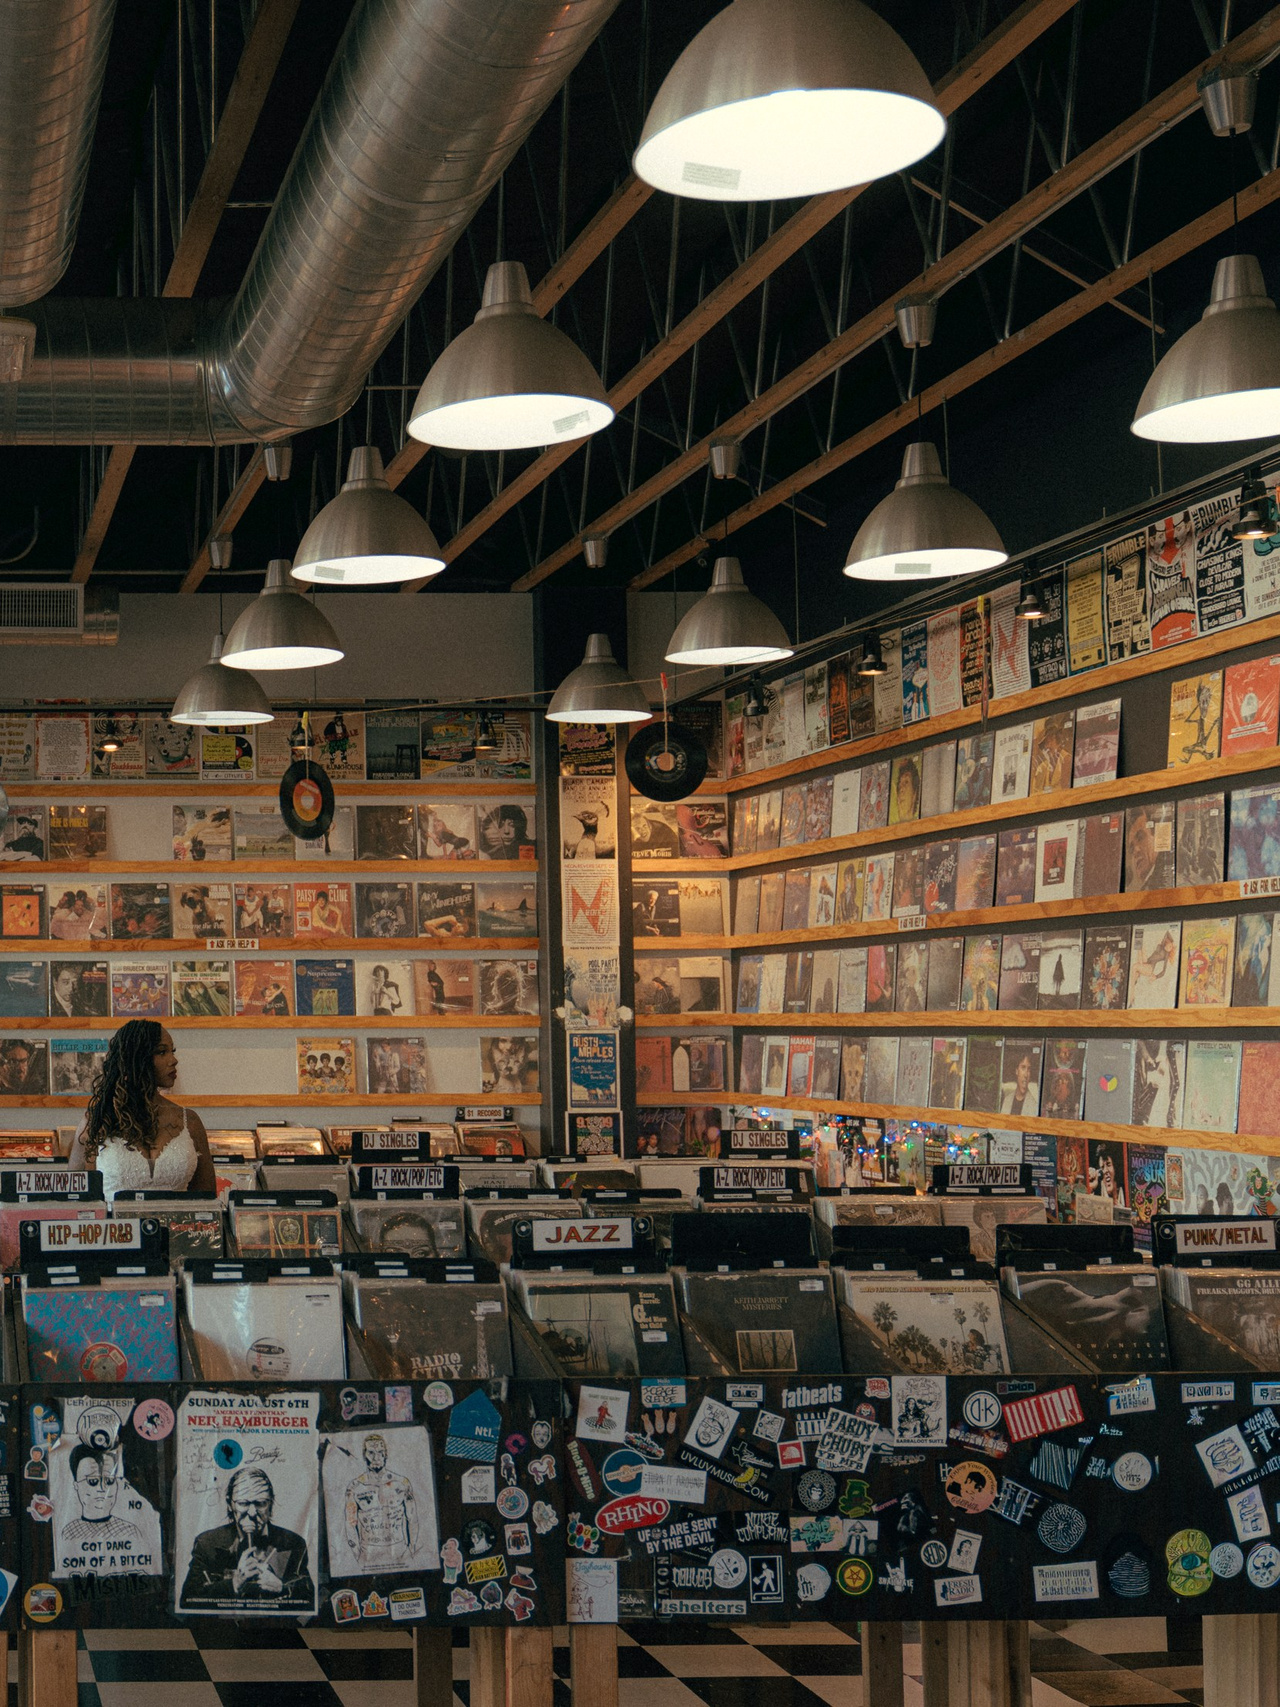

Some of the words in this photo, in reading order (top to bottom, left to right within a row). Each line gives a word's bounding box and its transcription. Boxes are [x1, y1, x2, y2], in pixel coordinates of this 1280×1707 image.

[1198, 494, 1241, 528] RUMBLE
[296, 890, 316, 901] PATSY
[328, 889, 348, 901] CLINE
[216, 940, 226, 949] ASK
[227, 940, 237, 949] FOR
[238, 940, 250, 948] HELP
[146, 964, 168, 972] QUARTET
[573, 1037, 598, 1048] RUSTY
[578, 1047, 614, 1058] MAPLES
[476, 1109, 502, 1119] RECORDS
[363, 1134, 376, 1149] DJ
[379, 1133, 417, 1148] SINGLES
[733, 1133, 744, 1148] DJ
[750, 1132, 786, 1148] SINGLES
[18, 1173, 31, 1191] A-Z
[34, 1173, 87, 1192] ROCK/POP/ETC
[374, 1169, 388, 1187] A-Z
[390, 1168, 442, 1188] ROCK/POP/ETC
[715, 1170, 730, 1188] A-Z
[733, 1168, 785, 1189] ROCK/POP/ETC
[950, 1169, 963, 1187] A-Z
[967, 1167, 1019, 1187] ROCK/POP/ETC
[48, 1223, 133, 1245] HIP-HOP/R&B
[545, 1224, 621, 1243] JAZZ
[1183, 1226, 1268, 1246] PUNK/METAL
[753, 1296, 788, 1304] JARRETT
[742, 1303, 782, 1311] MYSTERIES
[410, 1353, 462, 1367] RADIO
[411, 1364, 463, 1379] CITY
[781, 1383, 843, 1408] fatbeats
[188, 1398, 236, 1408] SUNDAY
[288, 1399, 309, 1409] 6TH
[187, 1415, 219, 1427] NEIL
[222, 1415, 309, 1428] HAMBURGER
[475, 1425, 495, 1438] Ntl.
[128, 1501, 142, 1510] NO
[602, 1499, 669, 1529] RHINO
[669, 1521, 691, 1536] ARE
[692, 1516, 718, 1532] SENT
[81, 1541, 102, 1552] GOT
[106, 1541, 132, 1551] DANG
[646, 1542, 660, 1554] BY
[663, 1538, 684, 1552] THE
[685, 1531, 715, 1547] DEVIL
[62, 1557, 86, 1568] SON
[90, 1556, 106, 1567] OF
[110, 1557, 117, 1566] A
[120, 1555, 152, 1566] BITCH
[948, 1580, 974, 1589] FRESH
[392, 1592, 421, 1601] WARNING
[949, 1587, 975, 1596] RADIO
